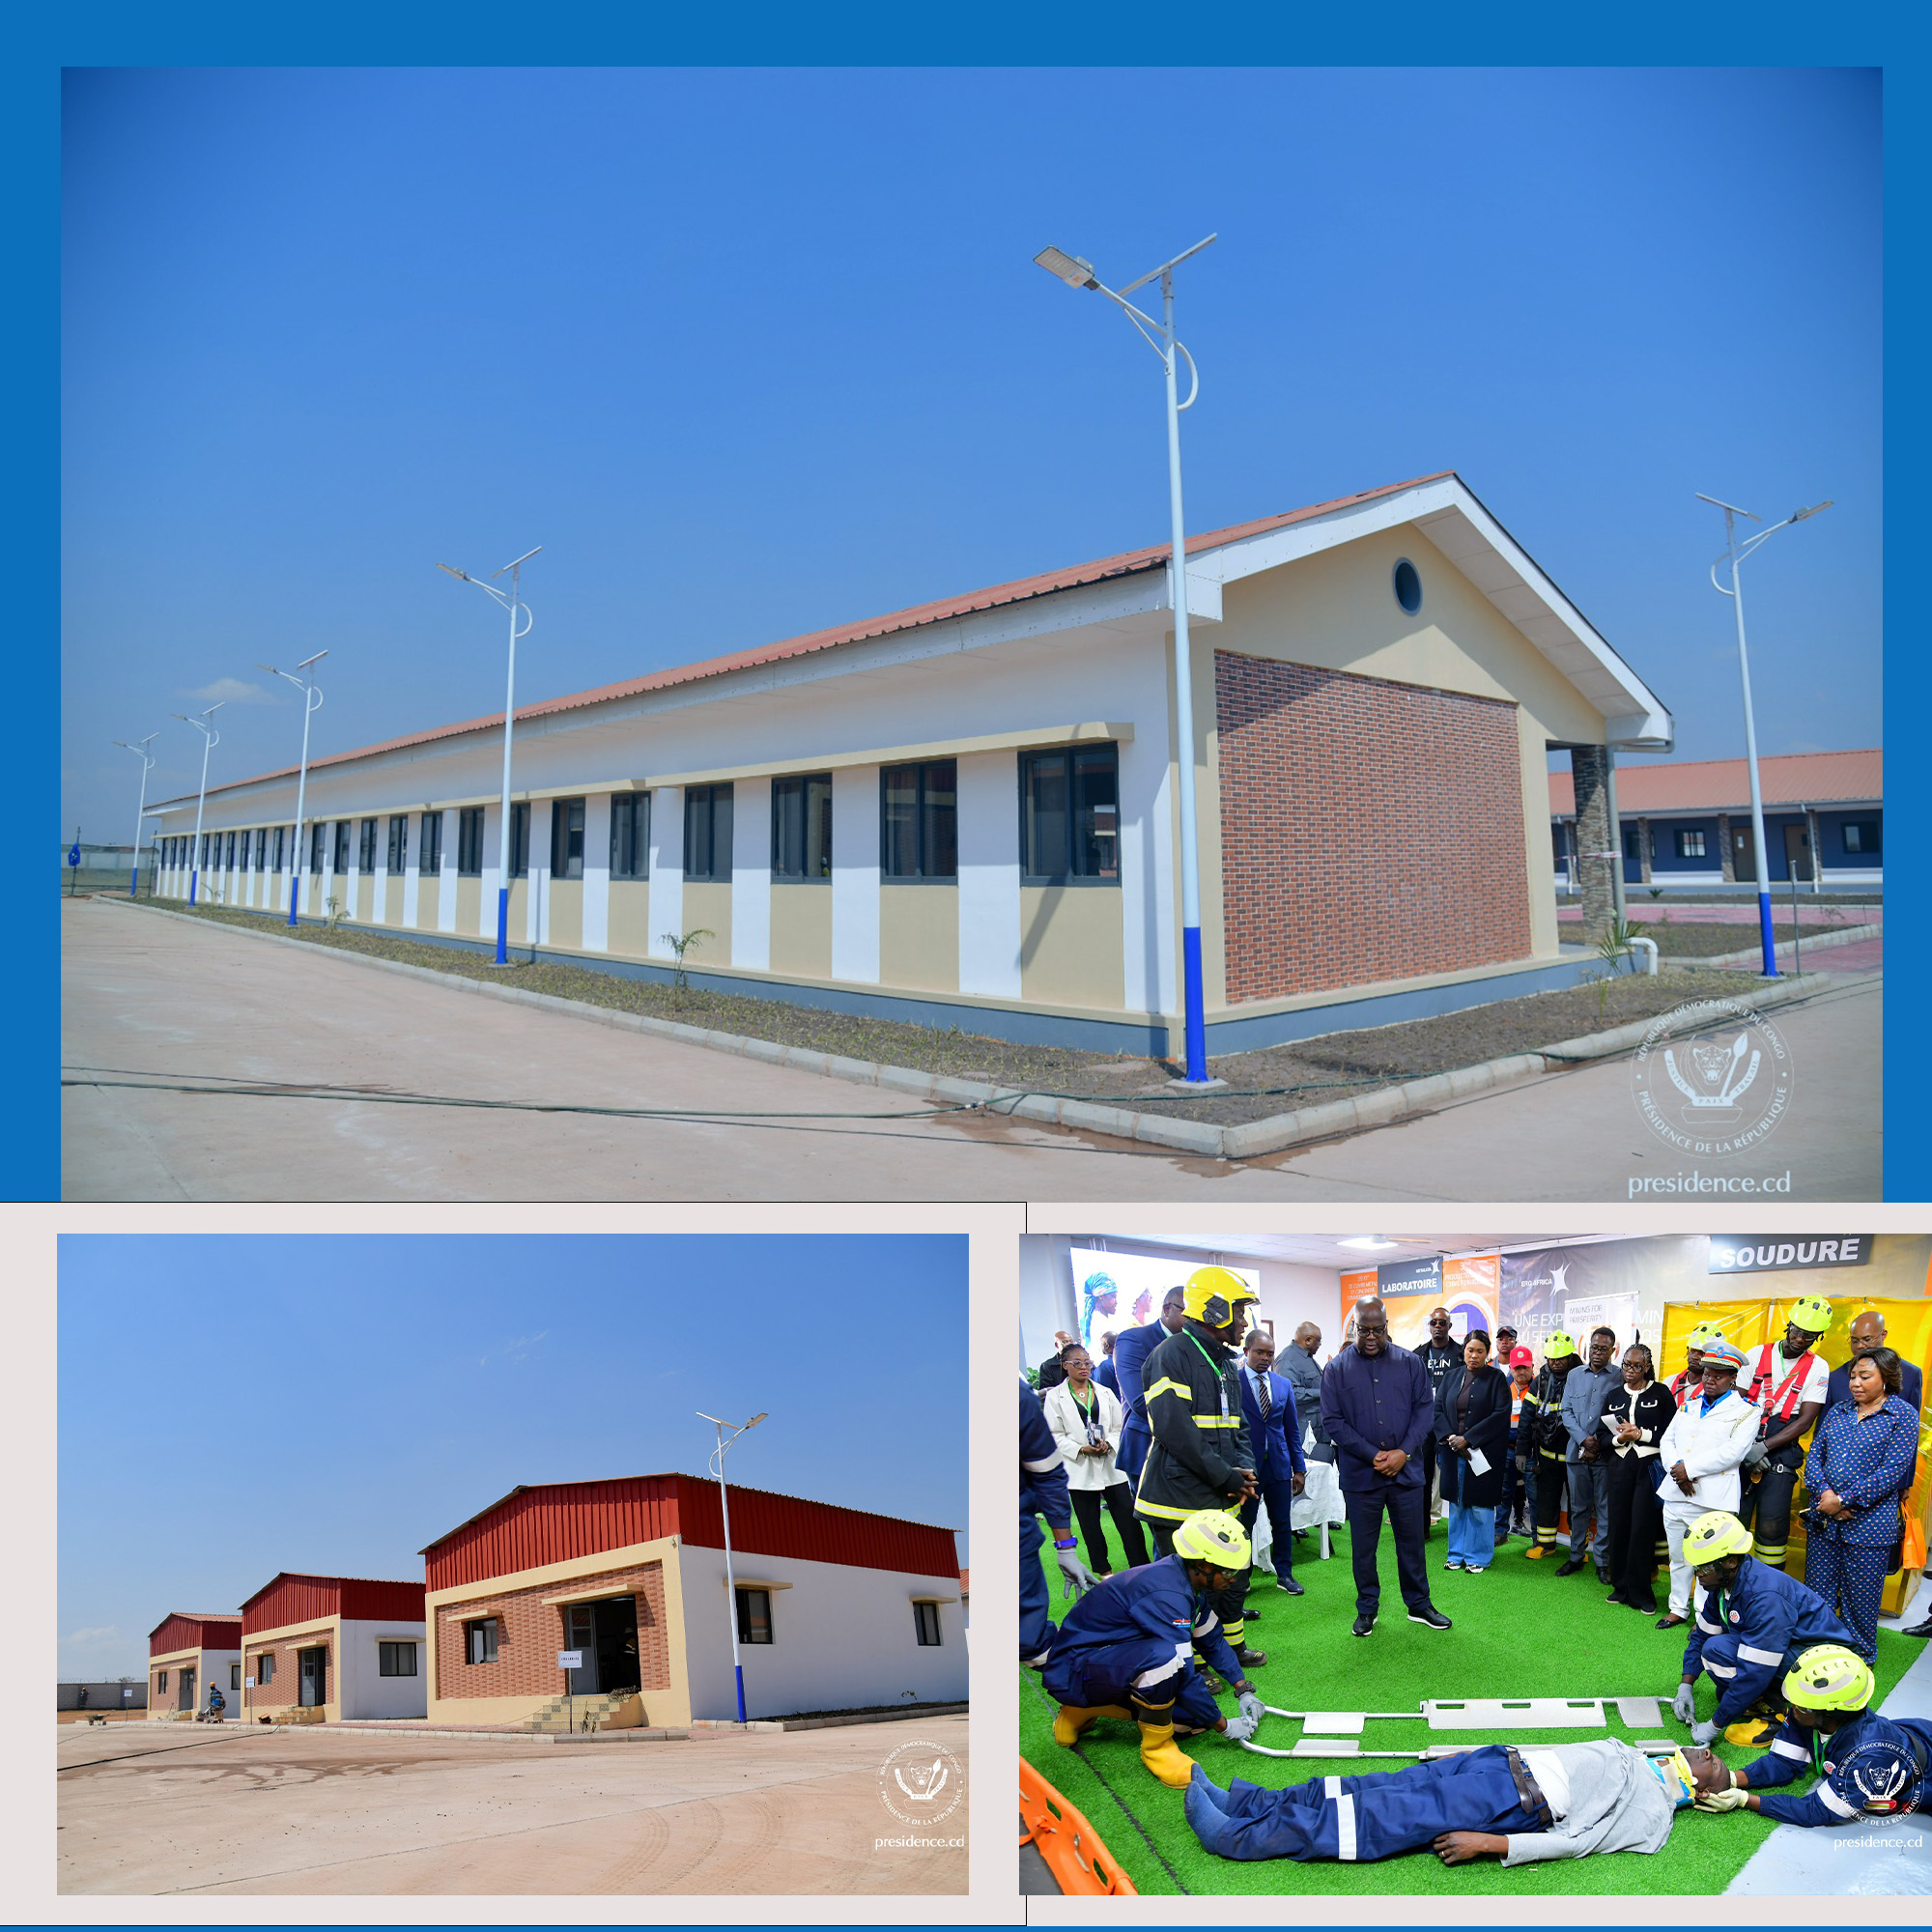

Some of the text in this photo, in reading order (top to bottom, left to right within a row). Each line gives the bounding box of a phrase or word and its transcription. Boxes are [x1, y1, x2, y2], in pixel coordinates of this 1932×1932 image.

[1719, 1237, 1861, 1268] SOUDURE
[1382, 1277, 1437, 1293] LABORATOIRE
[1569, 1304, 1603, 1314] MINING FOR
[1515, 1309, 1662, 1327] UNE EXP MIN
[1569, 1314, 1603, 1323] PROSPERITY
